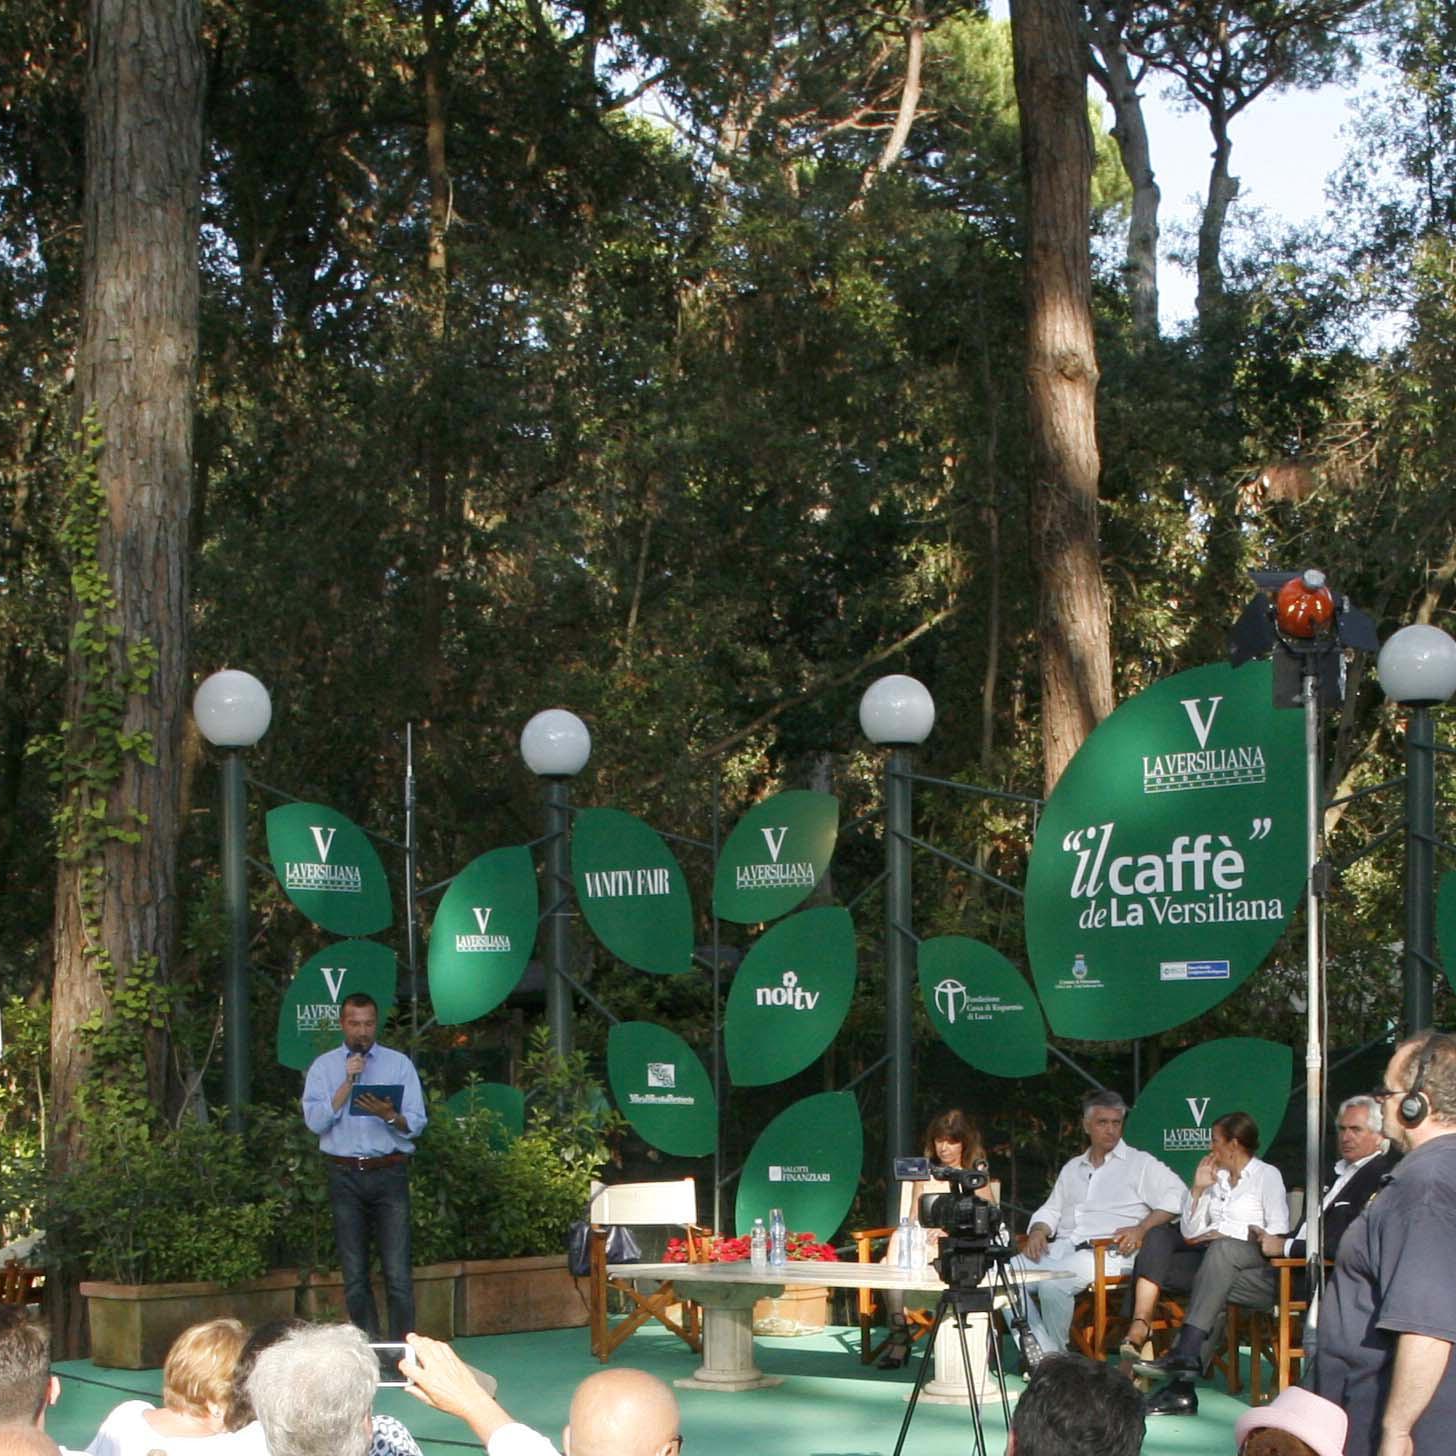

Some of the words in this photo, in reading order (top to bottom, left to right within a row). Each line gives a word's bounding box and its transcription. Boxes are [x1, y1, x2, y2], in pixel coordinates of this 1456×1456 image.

[585, 870, 634, 898] VANITY
[637, 868, 671, 896] FAIR
[1078, 900, 1107, 929] de
[1110, 897, 1144, 927] La
[1147, 893, 1284, 925] Versiliana
